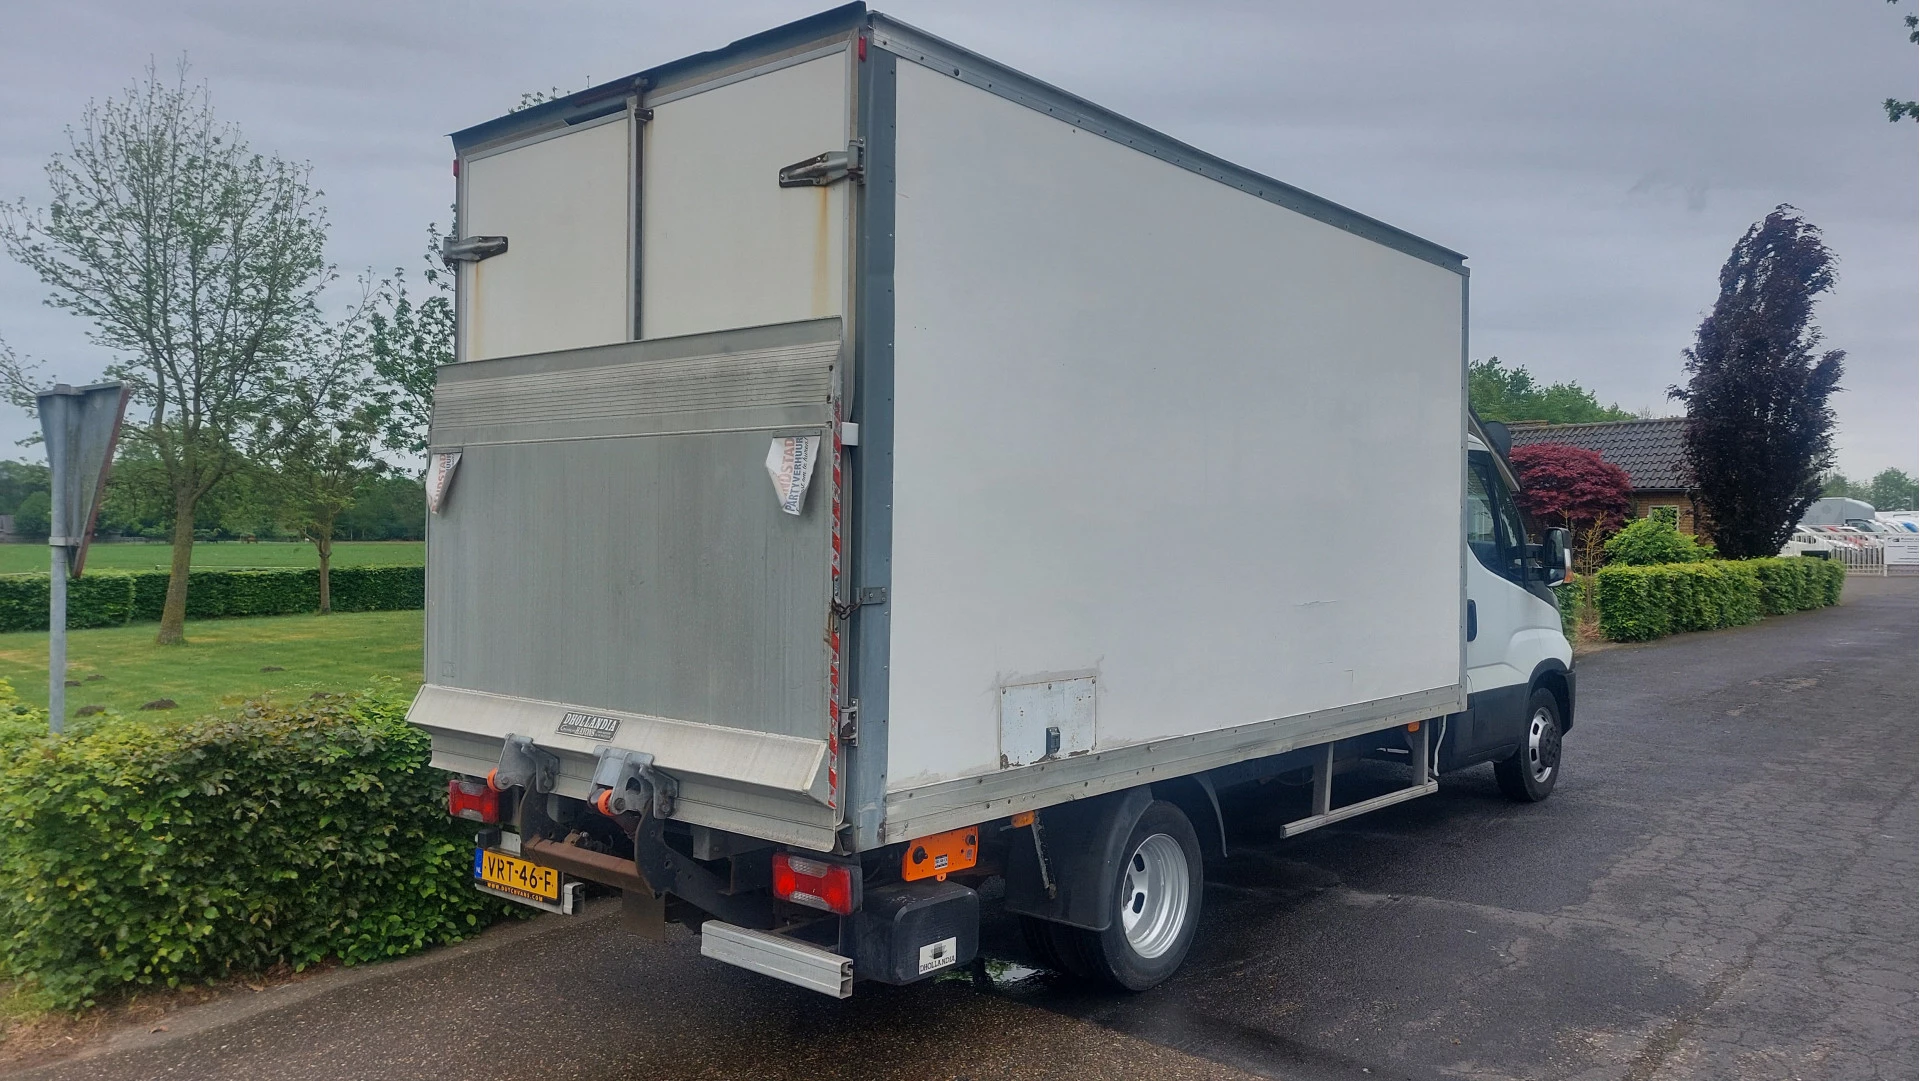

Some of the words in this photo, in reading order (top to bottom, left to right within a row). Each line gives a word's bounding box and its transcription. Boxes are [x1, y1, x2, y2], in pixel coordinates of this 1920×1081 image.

[785, 437, 804, 512] PARTYVERHUUR
[563, 713, 617, 732] DHOLLANDIA
[475, 866, 482, 874] NL
[488, 856, 552, 892] VRT-46-F
[486, 881, 543, 902] WWW.DUTCHVANS.COM
[919, 955, 956, 973] DHOLLANDIA
